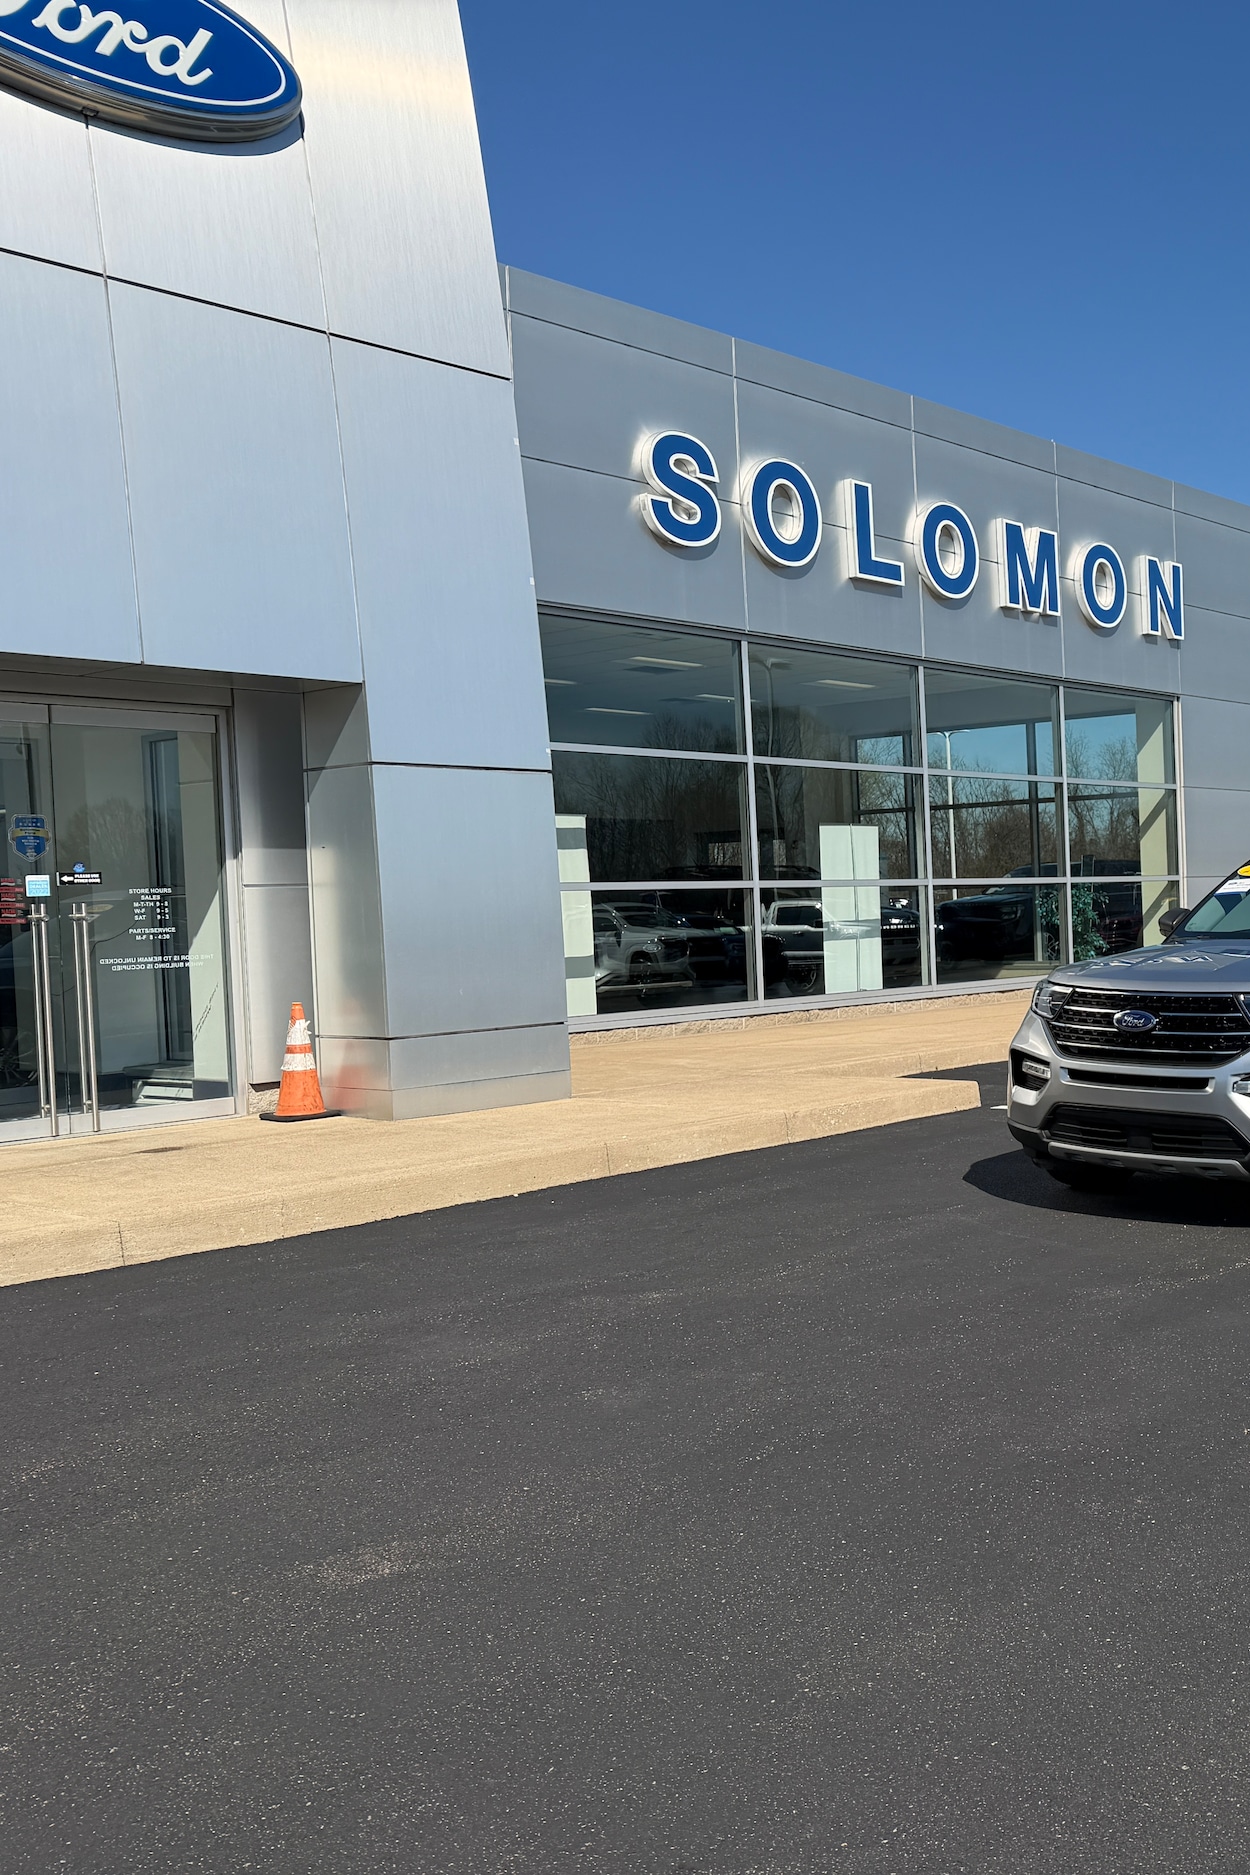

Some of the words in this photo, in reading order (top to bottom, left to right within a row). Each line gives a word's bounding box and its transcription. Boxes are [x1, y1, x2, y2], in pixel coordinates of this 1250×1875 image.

[0, 0, 213, 86] ord
[639, 429, 1185, 641] SOLOMON
[1121, 1014, 1146, 1027] Ford
